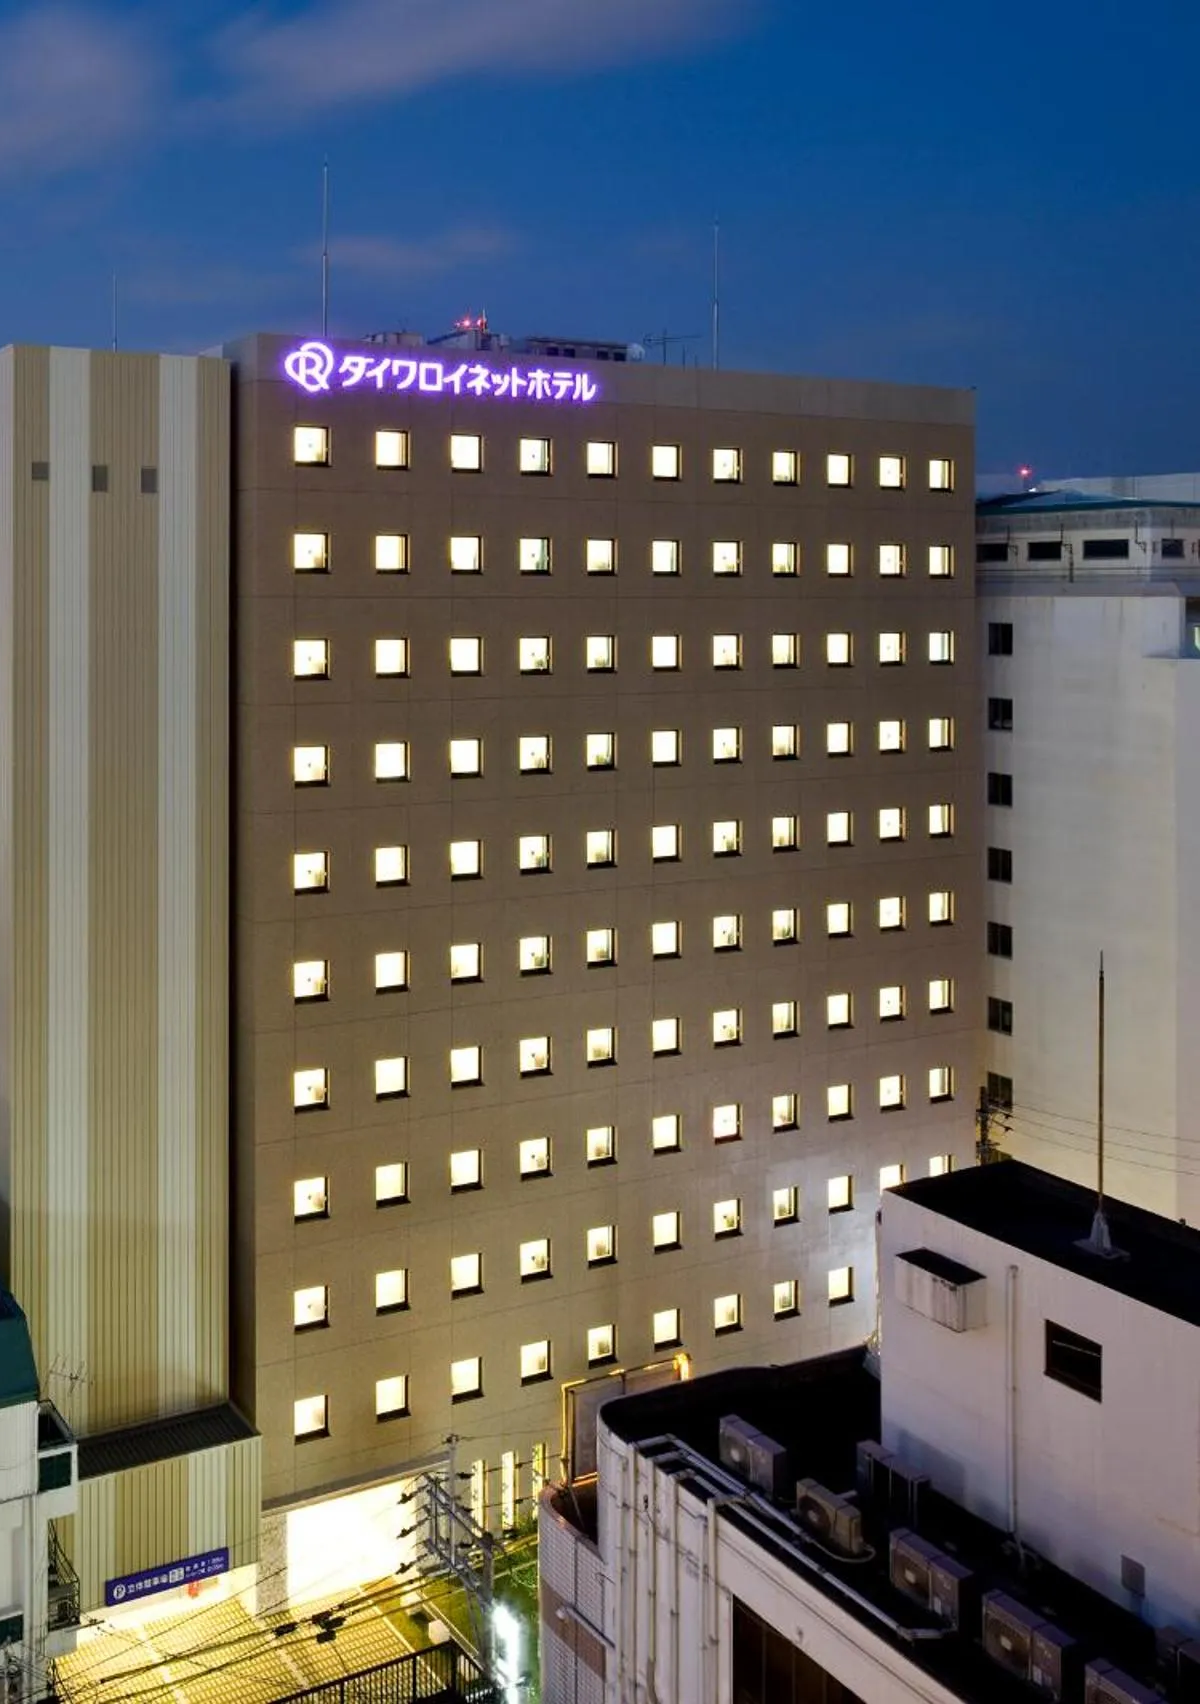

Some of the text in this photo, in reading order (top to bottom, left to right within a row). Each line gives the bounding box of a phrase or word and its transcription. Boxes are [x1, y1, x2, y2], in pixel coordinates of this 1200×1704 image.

[338, 354, 597, 401] ダイワロイネットホテル
